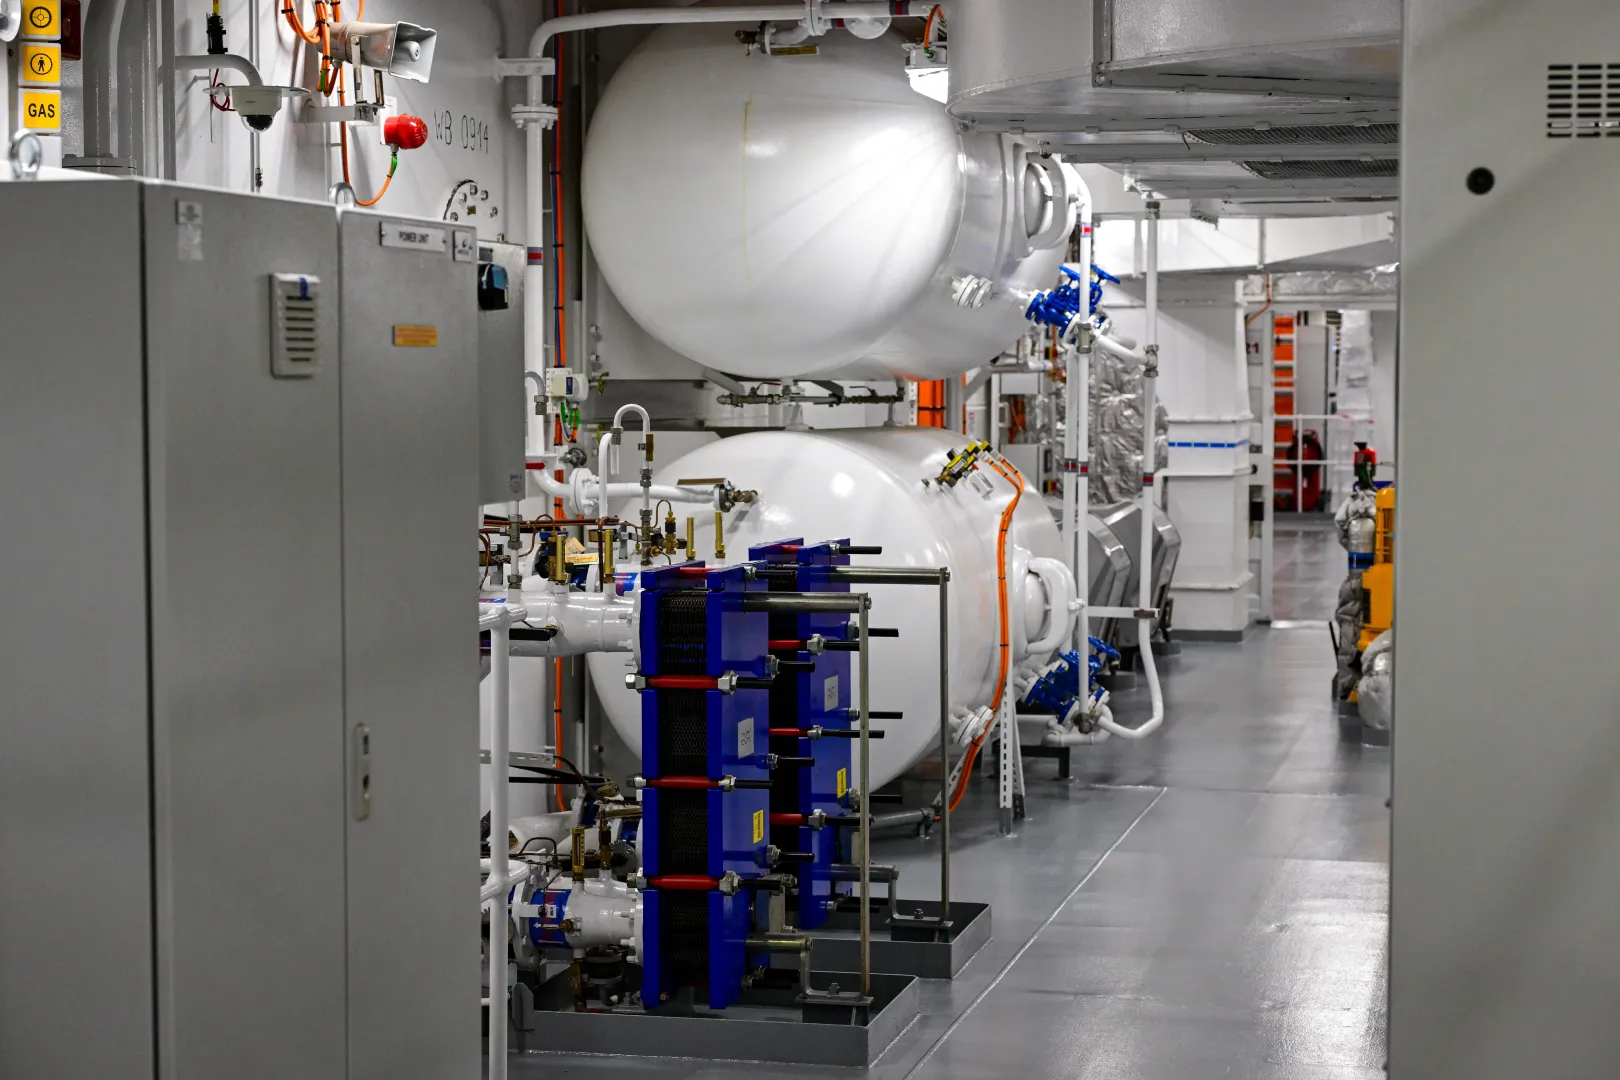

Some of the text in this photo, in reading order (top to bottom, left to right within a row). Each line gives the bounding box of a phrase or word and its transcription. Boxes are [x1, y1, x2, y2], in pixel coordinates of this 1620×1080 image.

[28, 103, 55, 118] GAS
[461, 115, 489, 154] 0914
[399, 231, 417, 243] POWER
